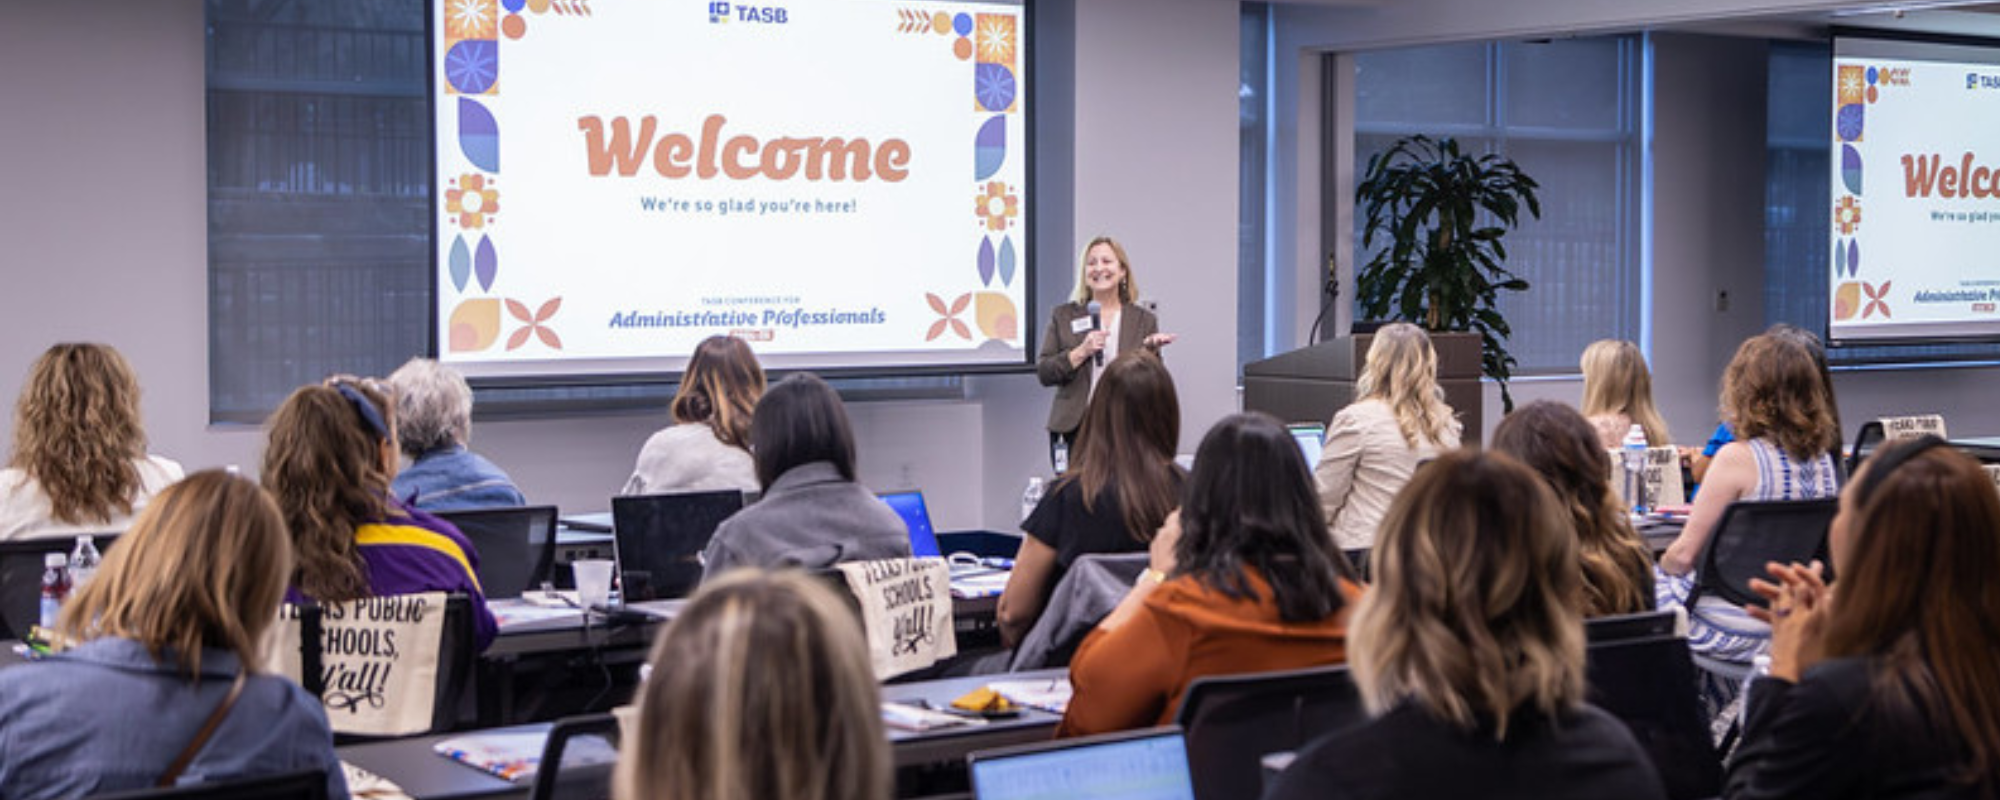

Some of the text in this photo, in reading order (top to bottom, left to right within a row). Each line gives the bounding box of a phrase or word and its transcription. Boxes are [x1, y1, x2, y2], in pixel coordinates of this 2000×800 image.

[735, 5, 788, 23] TASB
[577, 113, 911, 182] Welcome
[641, 197, 857, 215] We're so glad you're here!
[609, 307, 886, 329] Administrative Professionals
[354, 598, 426, 623] PUBLIC
